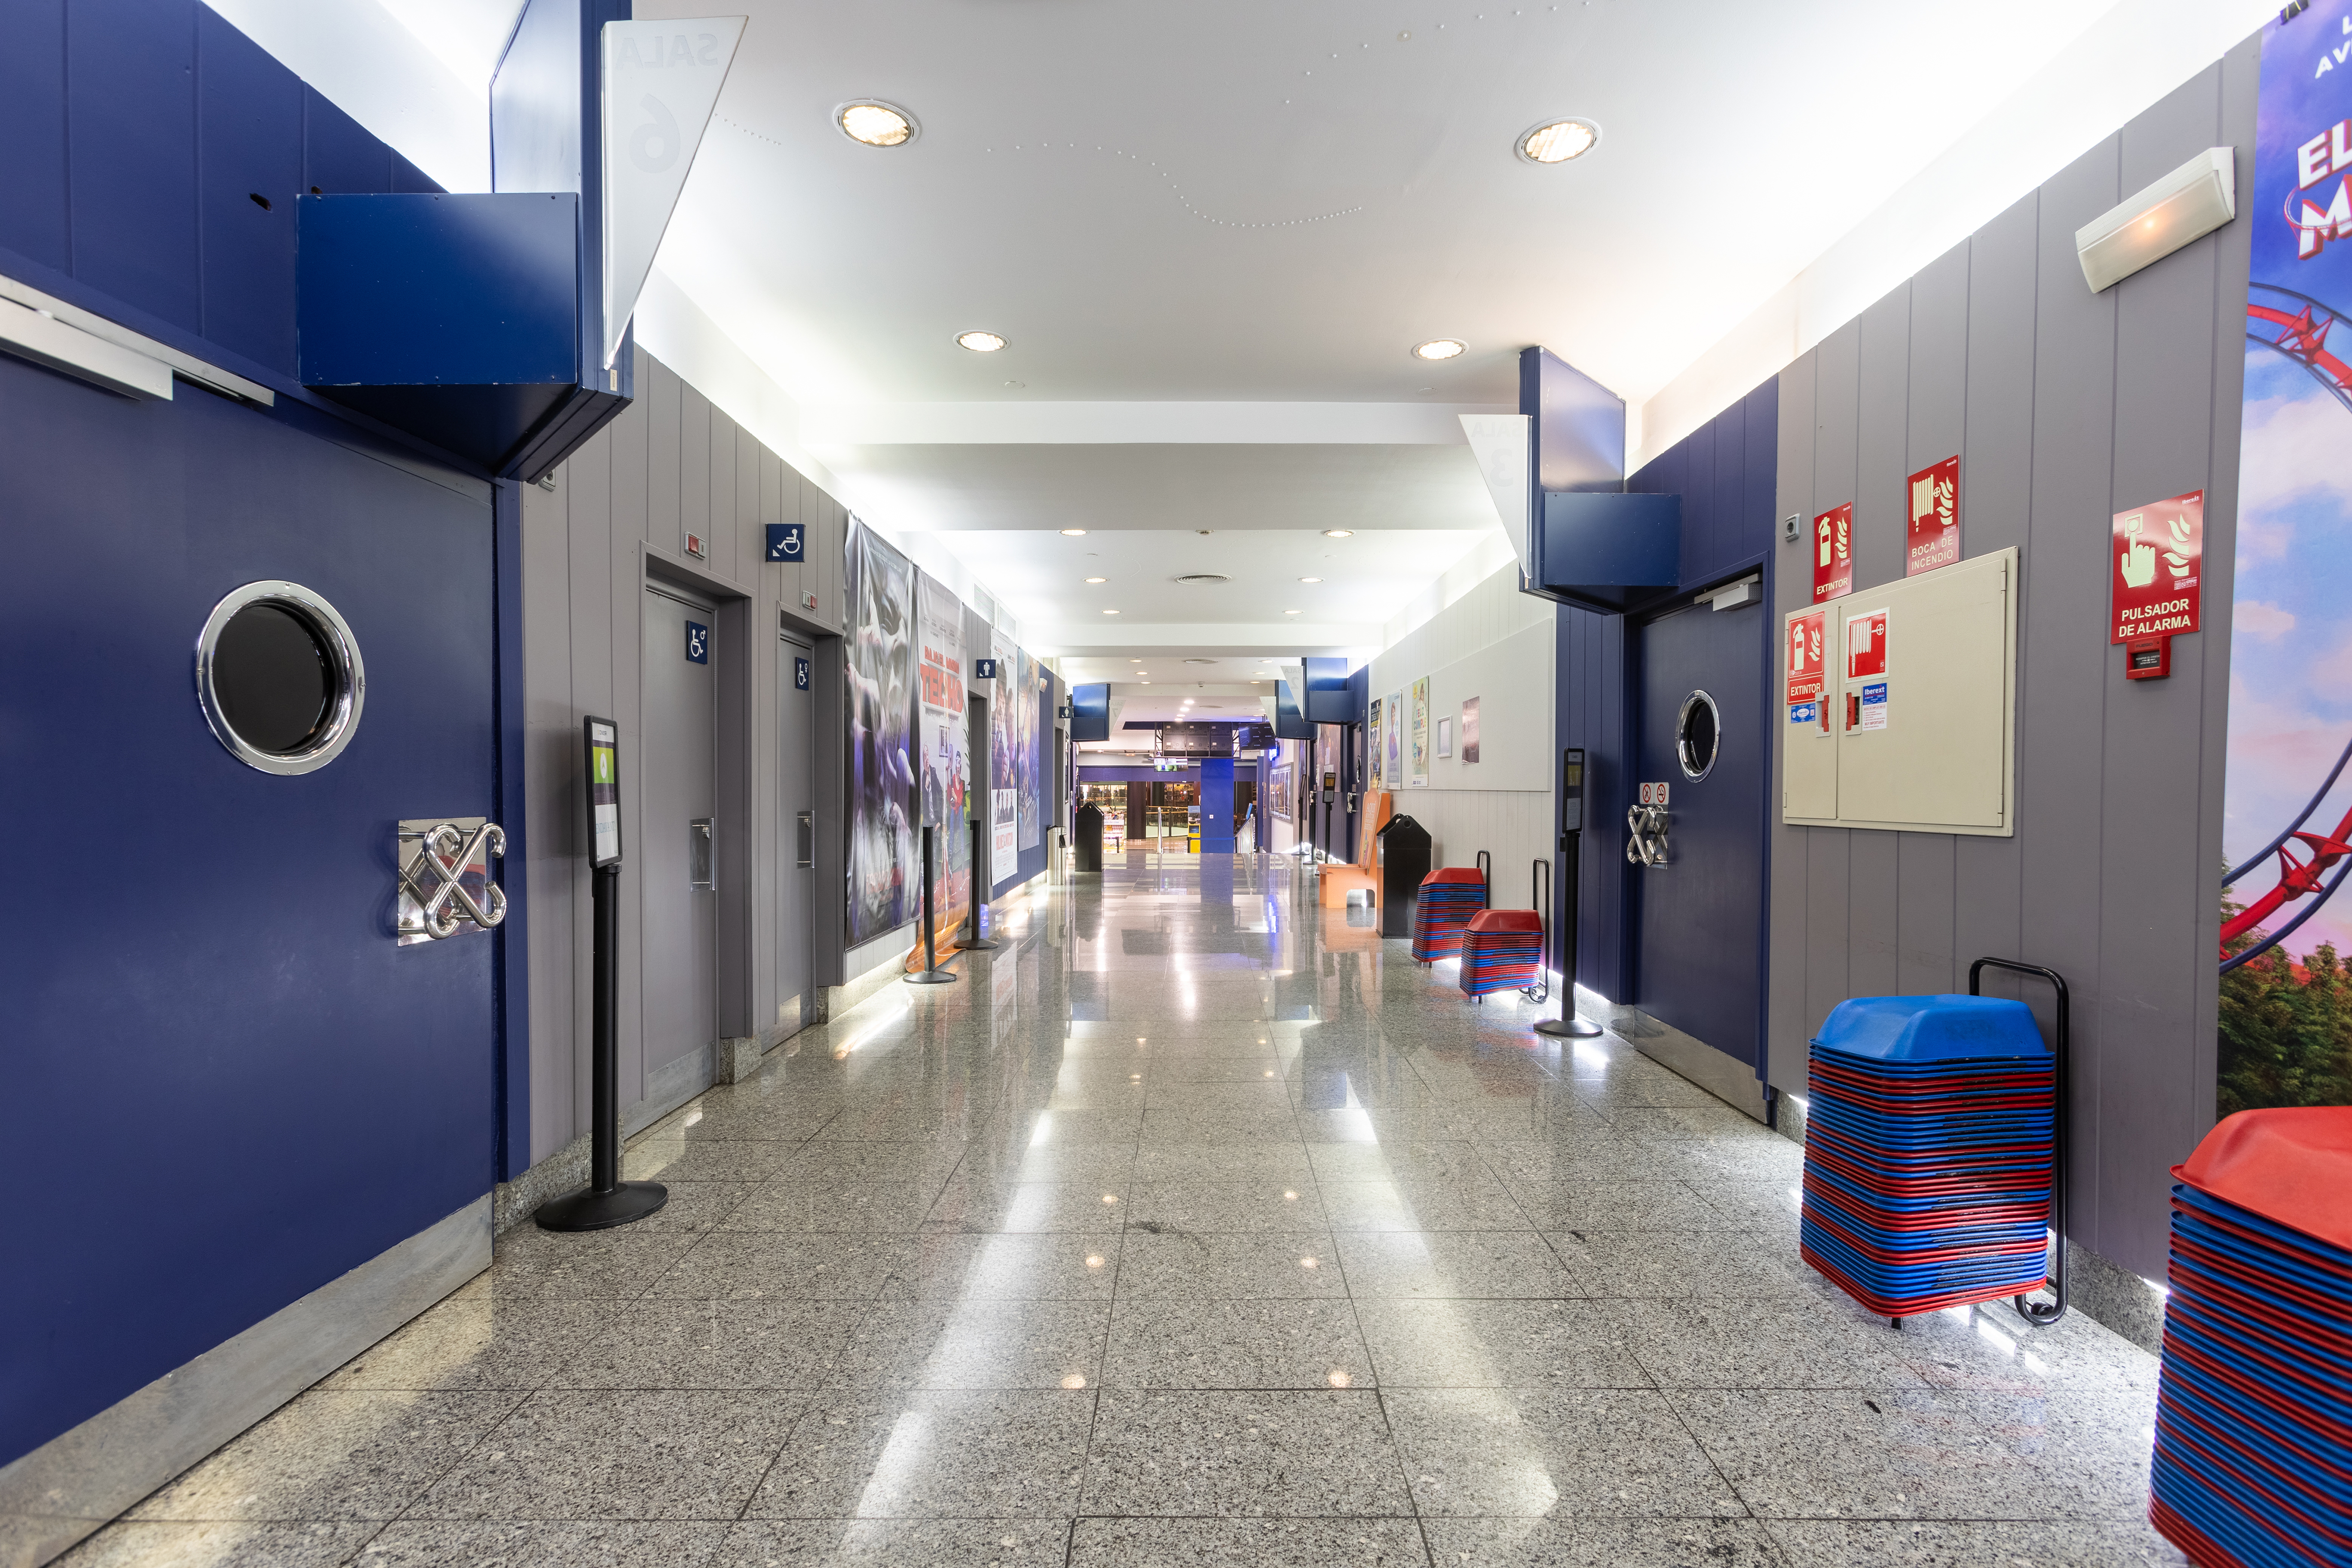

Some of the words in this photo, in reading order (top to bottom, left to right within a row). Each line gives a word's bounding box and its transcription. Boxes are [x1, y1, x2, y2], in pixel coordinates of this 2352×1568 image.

[2315, 38, 2352, 79] AV
[2298, 174, 2352, 260] M
[1912, 542, 1936, 558] BOCA
[1942, 535, 1953, 548] DE
[1911, 549, 1953, 571] INCENDIO
[1816, 577, 1848, 595] EXTINTOR
[2121, 598, 2189, 622] PULSADOR
[2119, 624, 2135, 637] DE
[2136, 615, 2191, 634] ALARMA
[925, 646, 938, 664] BAJO
[939, 653, 945, 667] EL
[946, 656, 959, 674] MISMO
[920, 663, 963, 713] TECHO
[1791, 683, 1821, 696] EXTINTOR
[1865, 686, 1885, 695] Iberext
[1414, 717, 1427, 731] CUMPLE
[1416, 707, 1424, 719] FELIZ
[1366, 800, 1376, 815] AQUÍ
